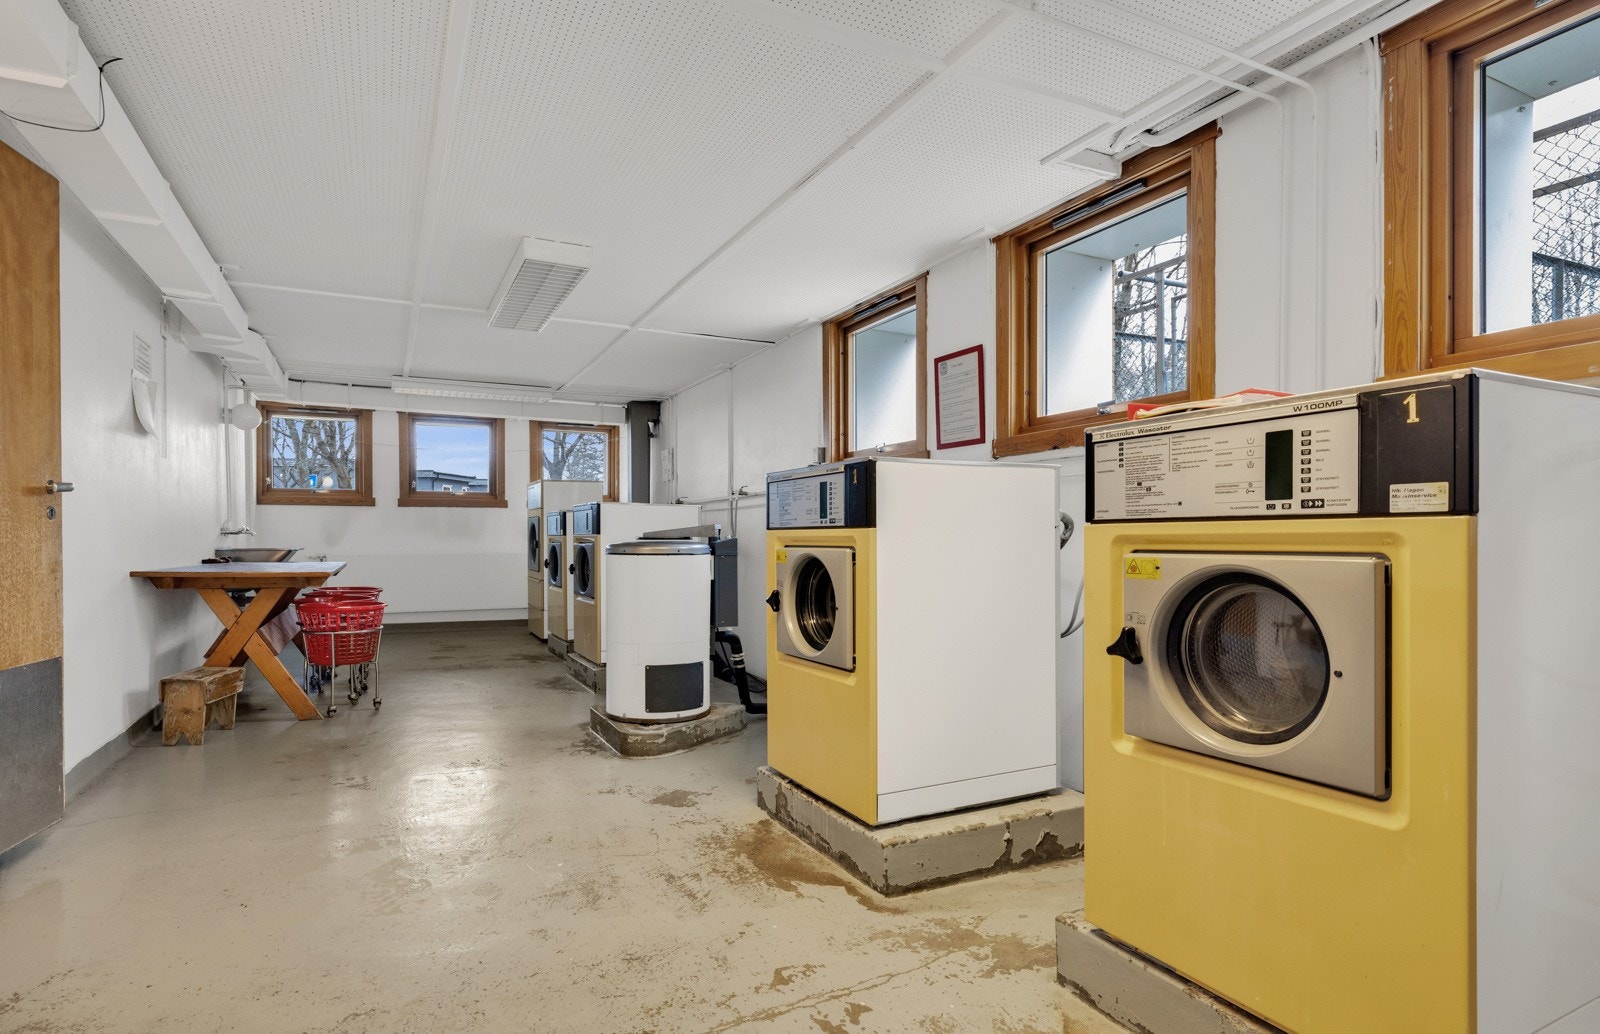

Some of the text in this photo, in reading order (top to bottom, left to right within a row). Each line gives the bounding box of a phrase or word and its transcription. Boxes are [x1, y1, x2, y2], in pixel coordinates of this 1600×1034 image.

[1293, 400, 1343, 413] W100MP
[1403, 393, 1419, 423] 1
[1105, 425, 1172, 439] Electrolux Wascator
